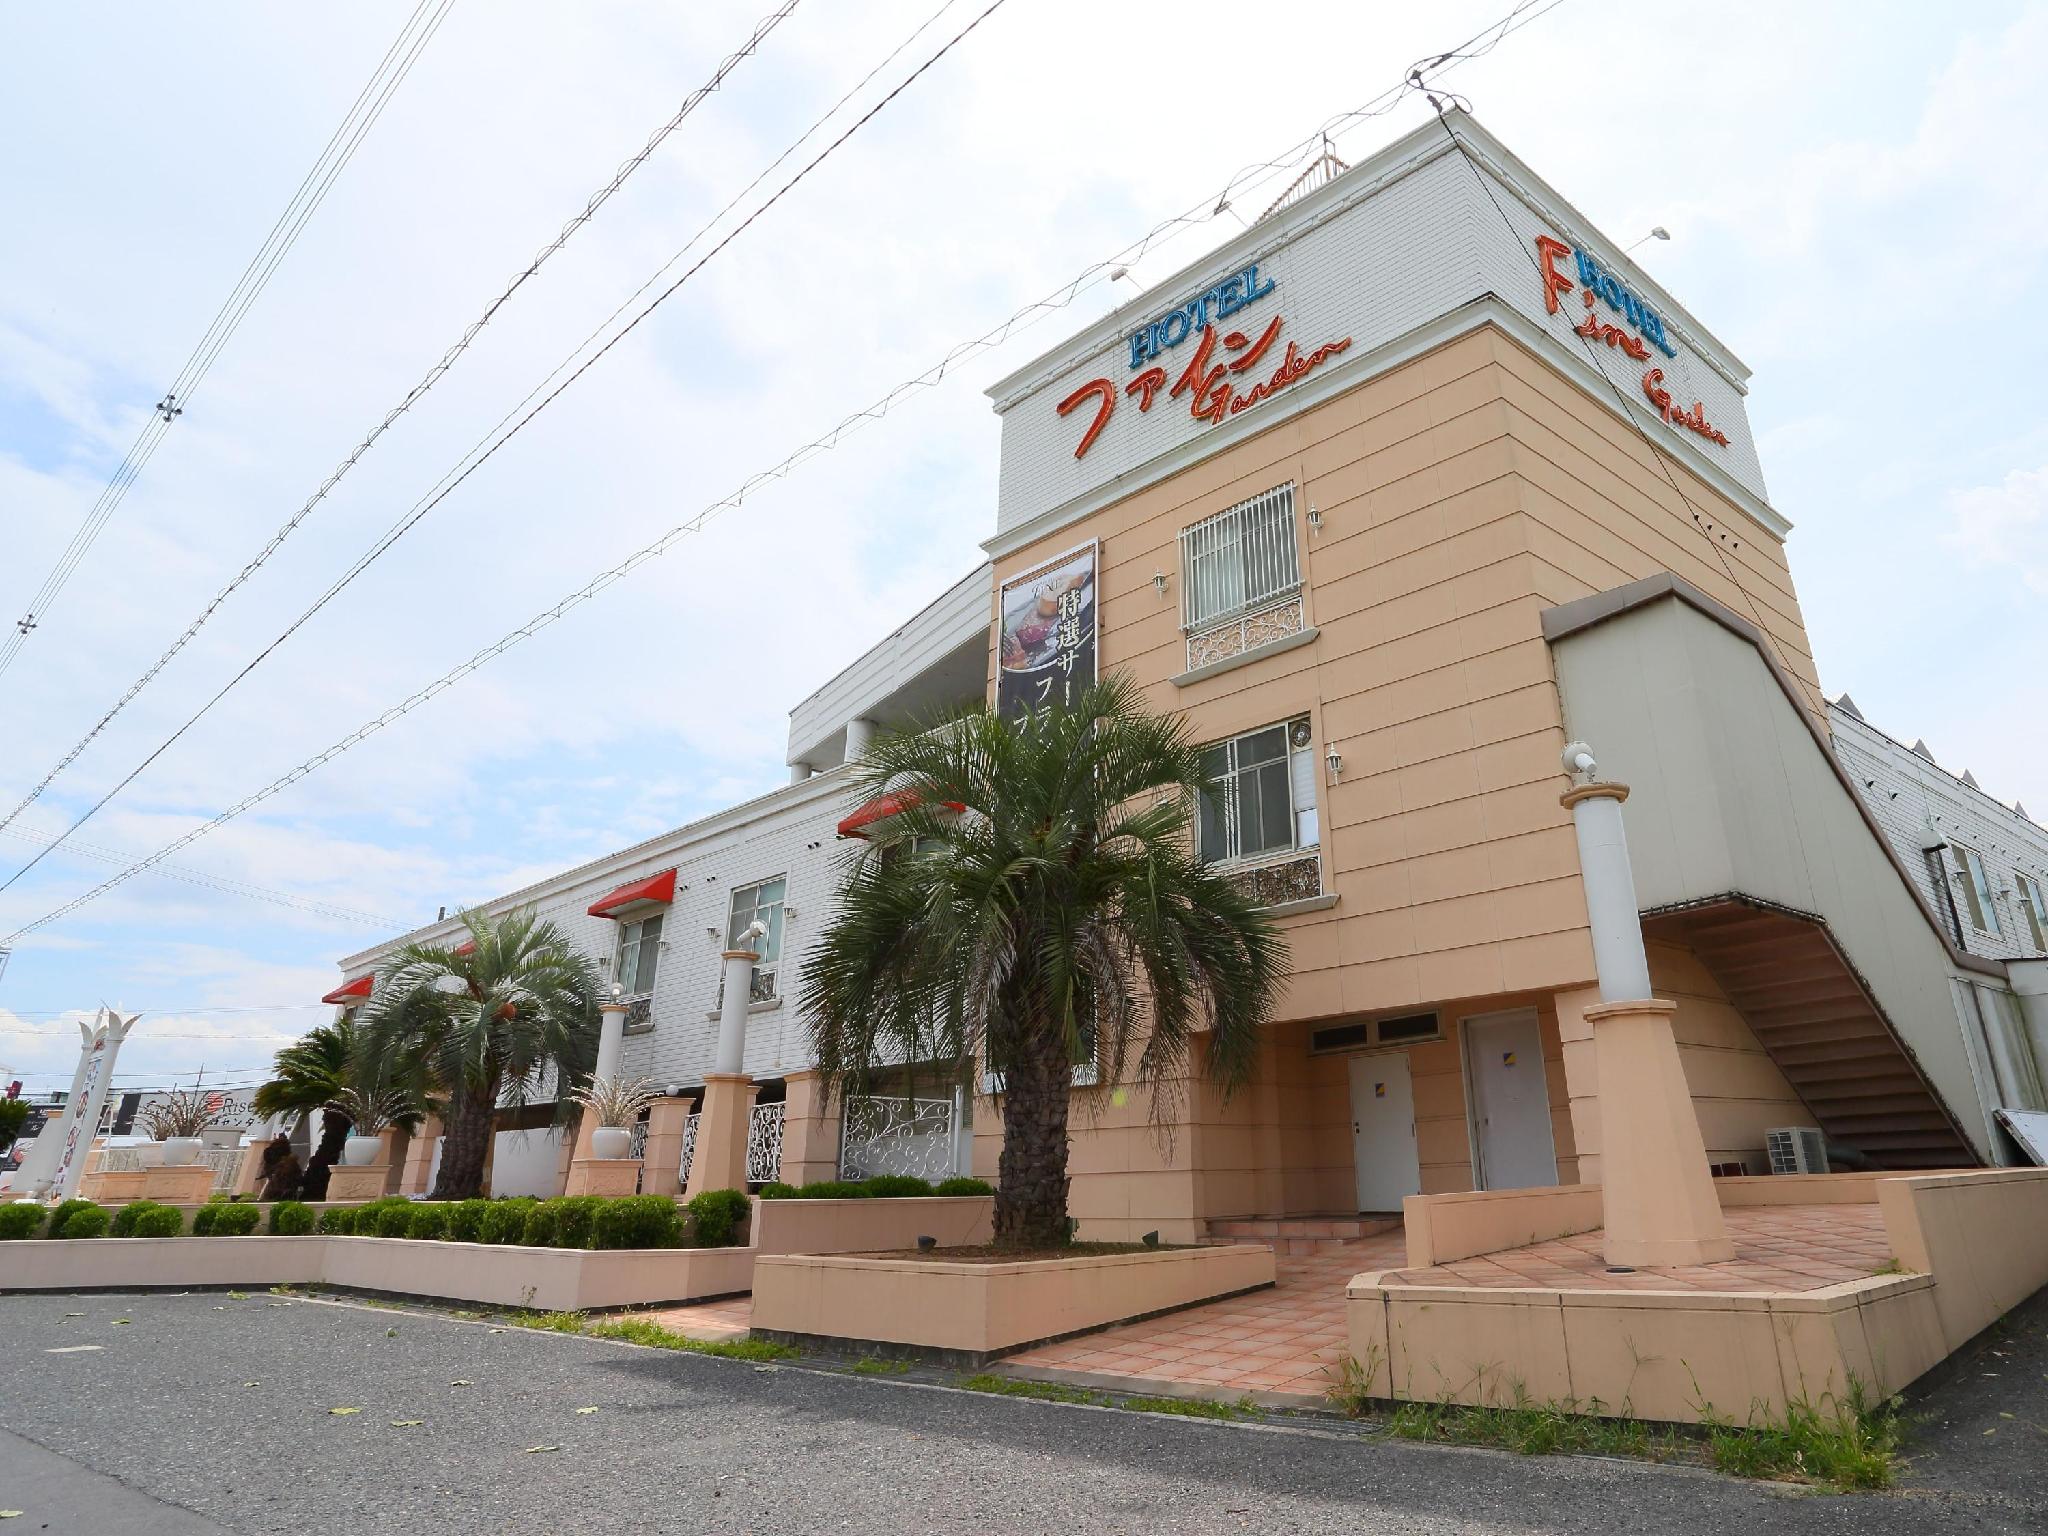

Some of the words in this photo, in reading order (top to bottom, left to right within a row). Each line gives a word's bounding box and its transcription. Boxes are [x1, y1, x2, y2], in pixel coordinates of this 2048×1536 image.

[1128, 265, 1276, 369] HOTEL
[1535, 234, 1651, 361] Fine
[1574, 246, 1677, 359] HOTEL
[1056, 314, 1284, 460] ファイン
[1191, 336, 1352, 426] Garden
